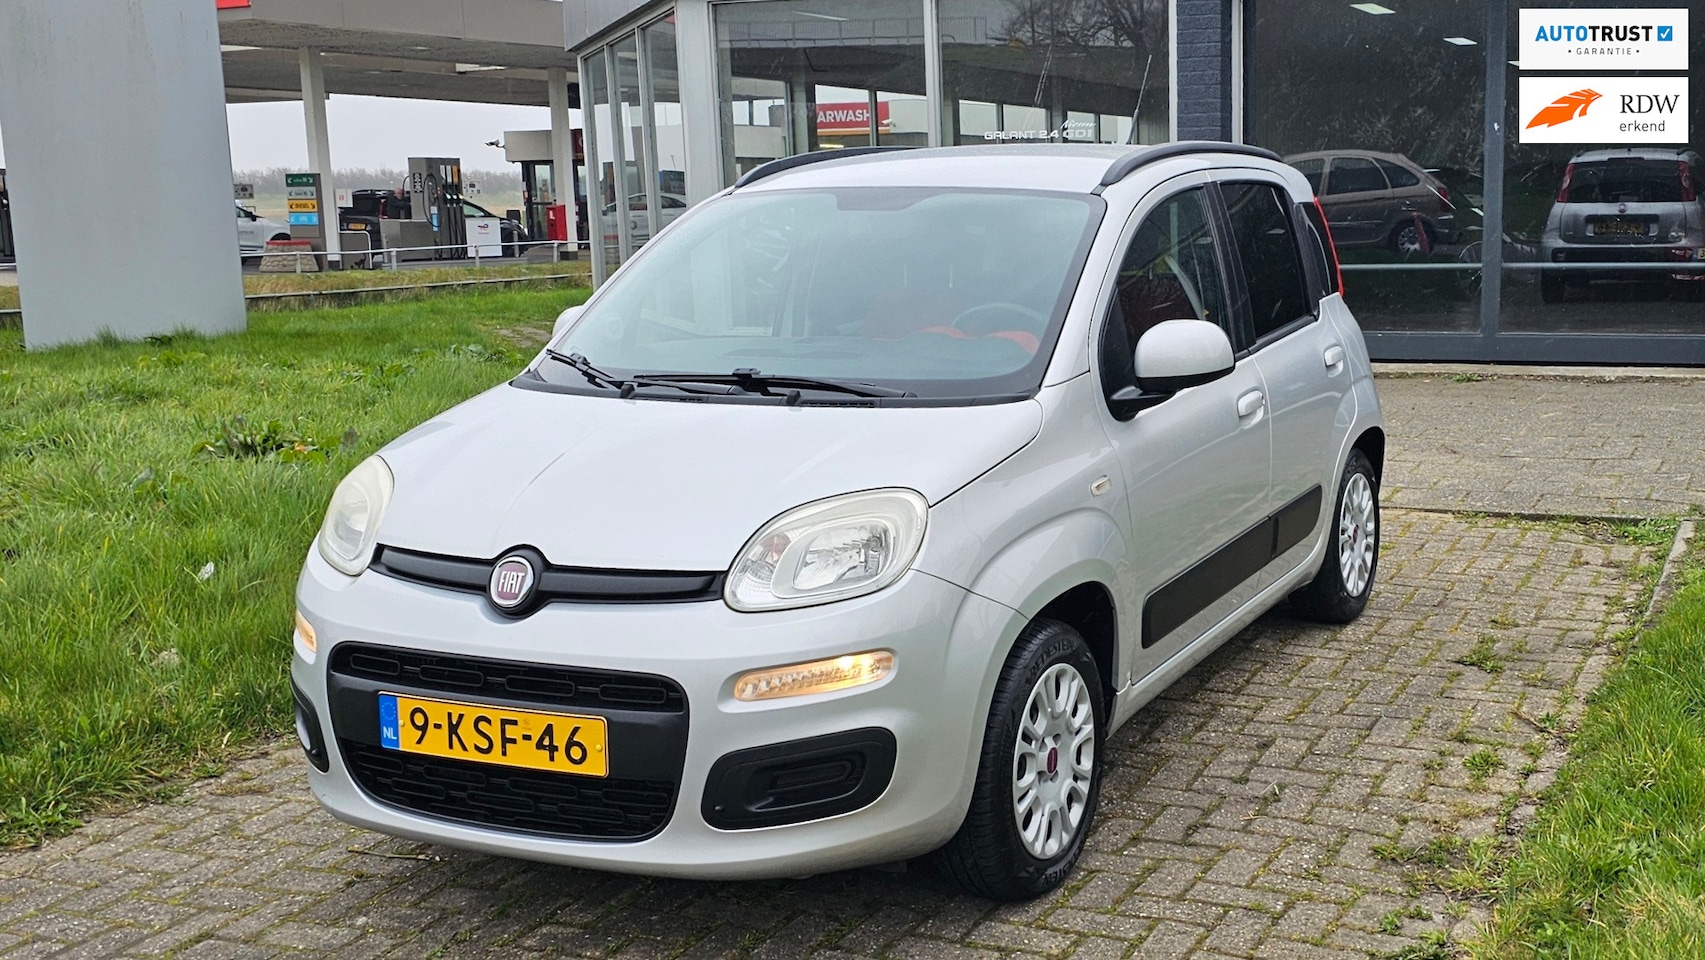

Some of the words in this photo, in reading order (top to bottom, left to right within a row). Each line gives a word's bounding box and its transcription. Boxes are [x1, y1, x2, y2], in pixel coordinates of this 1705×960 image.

[816, 109, 871, 123] ARWASH
[984, 130, 1036, 140] GALANT
[1039, 129, 1059, 139] 2.4
[1062, 128, 1093, 138] GDI
[497, 570, 526, 594] FIAT
[382, 726, 398, 740] NL
[409, 706, 588, 766] 9-KSF-46
